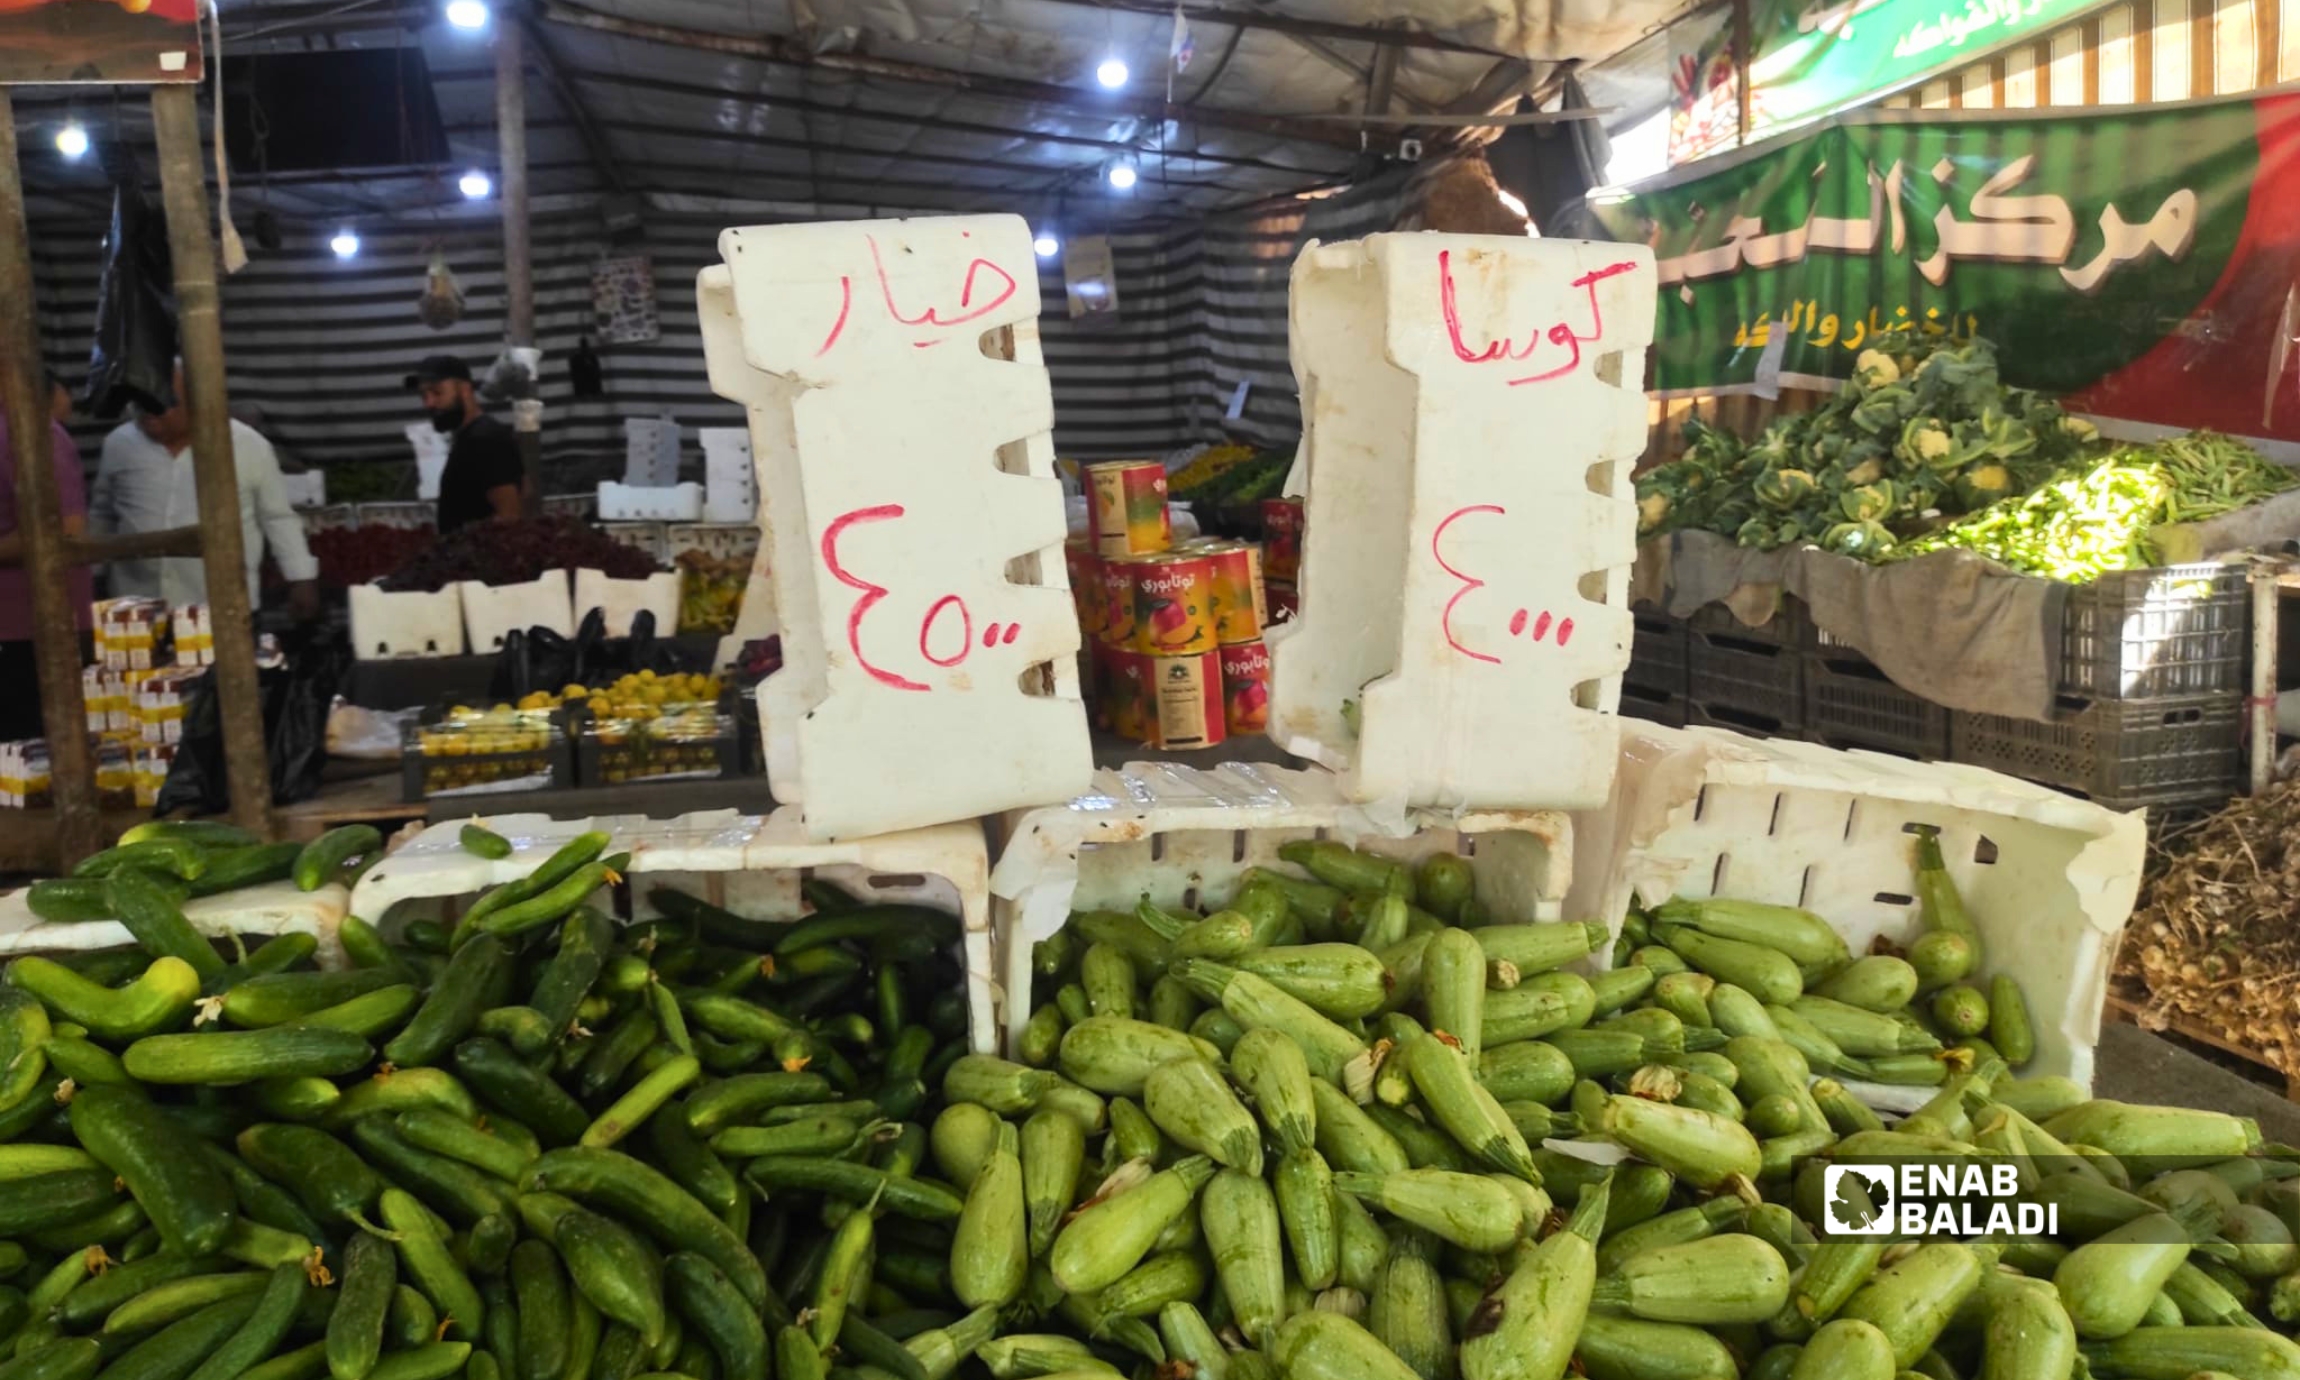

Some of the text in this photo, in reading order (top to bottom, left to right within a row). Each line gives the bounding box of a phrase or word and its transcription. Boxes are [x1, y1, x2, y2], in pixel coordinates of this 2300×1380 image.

[1913, 154, 2196, 291] مركز
[814, 231, 1017, 358] خيار
[1438, 249, 1637, 387] كوسا
[820, 503, 1021, 692] ٤٥٠٠
[1431, 504, 1575, 664] ٤٠٠٠
